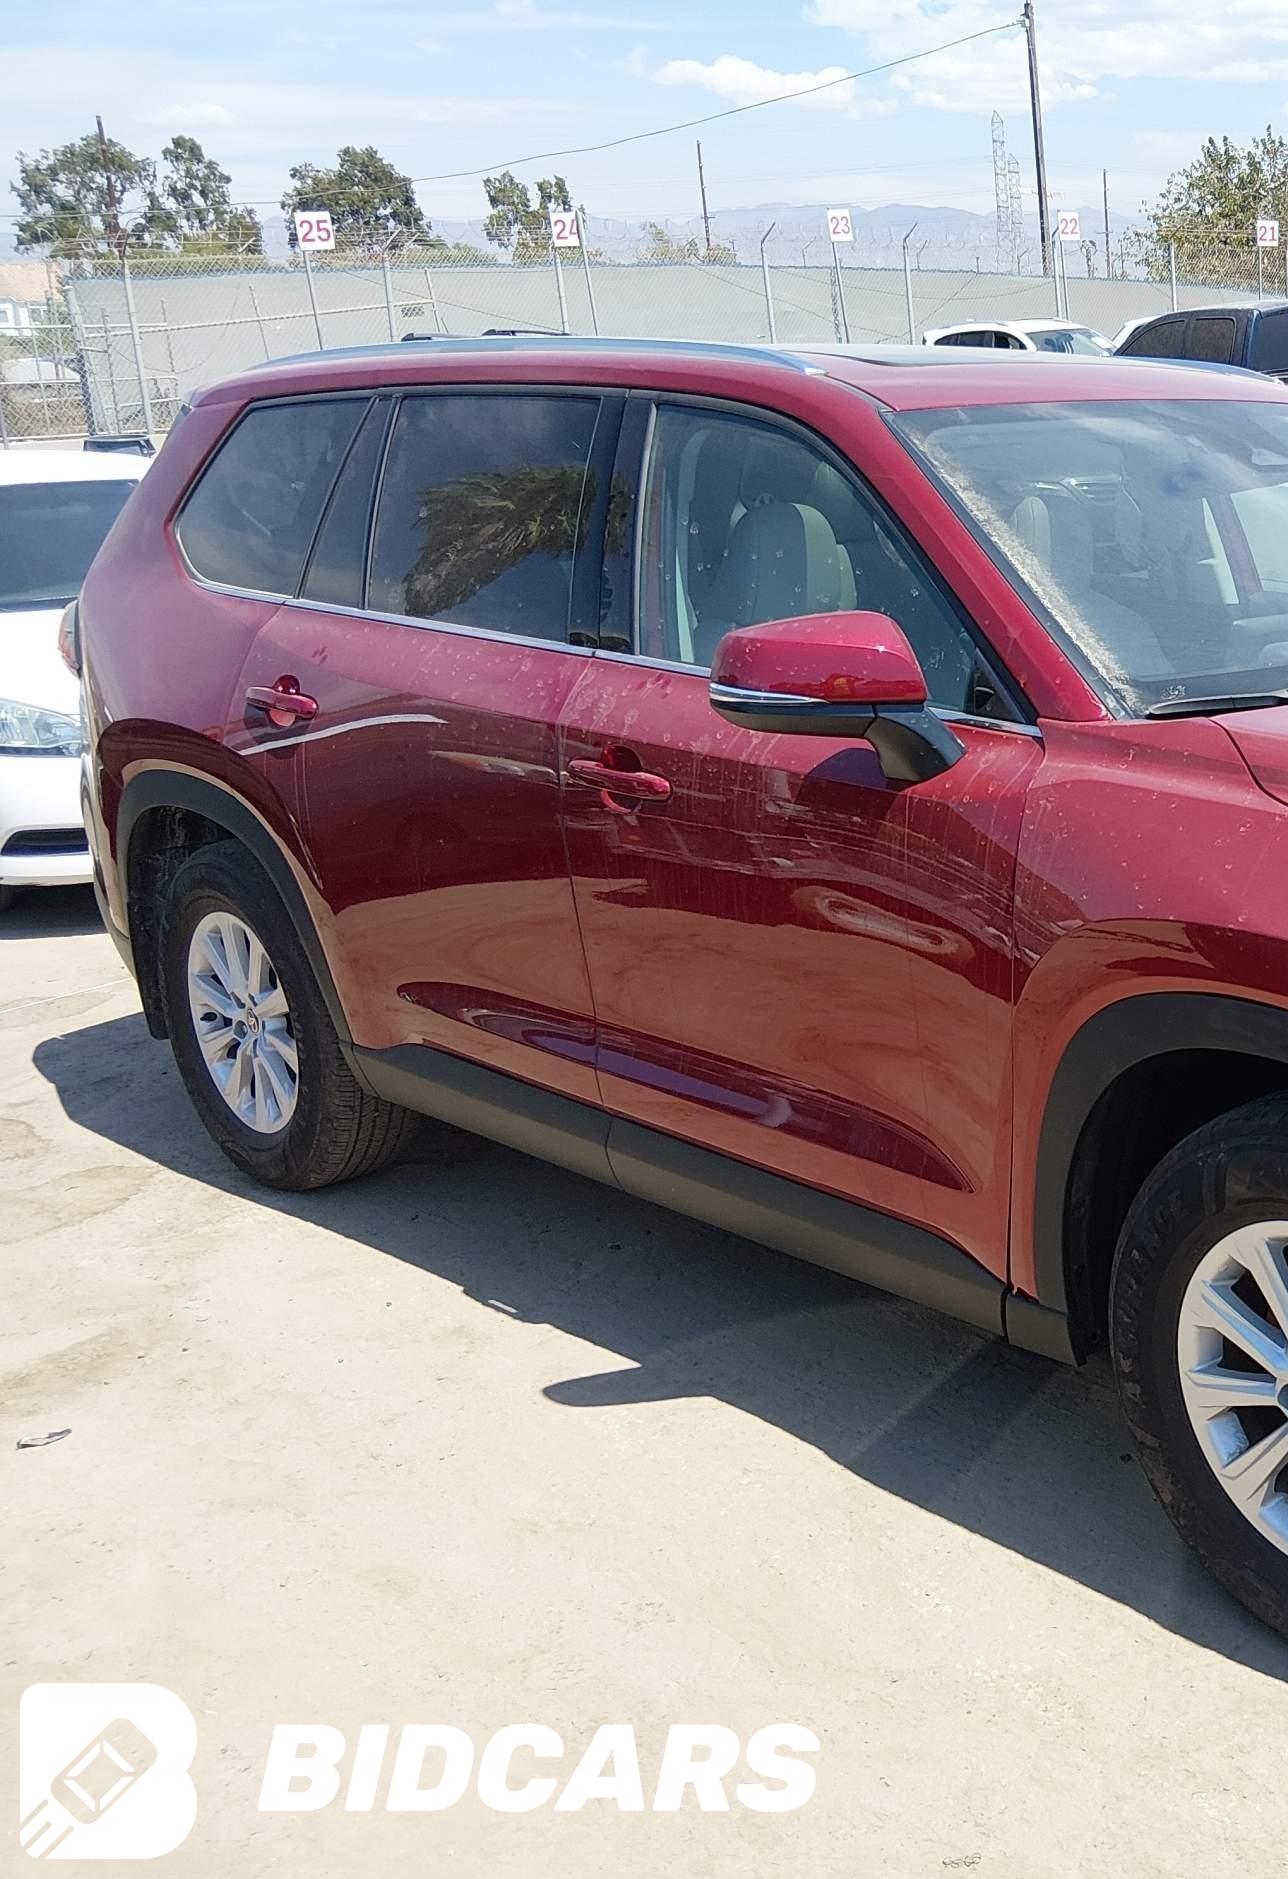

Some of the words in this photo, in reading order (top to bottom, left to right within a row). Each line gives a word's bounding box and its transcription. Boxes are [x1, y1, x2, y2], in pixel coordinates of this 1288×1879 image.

[299, 219, 331, 242] 25
[830, 215, 850, 235] 23
[1060, 217, 1079, 235] 22
[1258, 225, 1277, 241] 21
